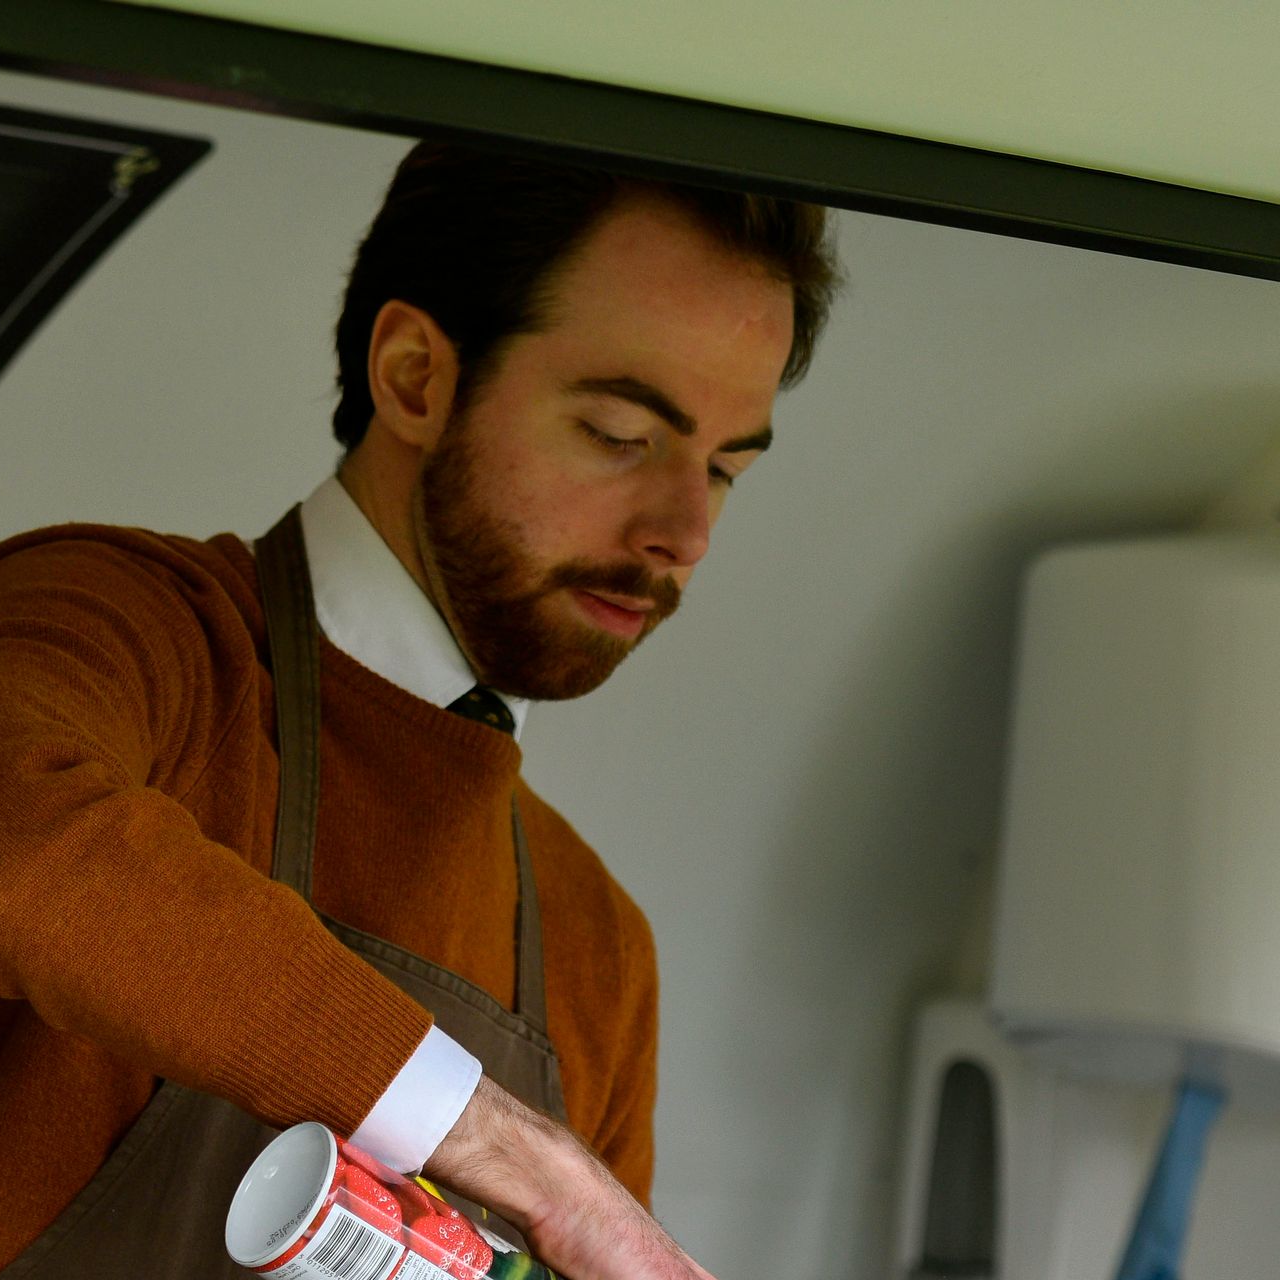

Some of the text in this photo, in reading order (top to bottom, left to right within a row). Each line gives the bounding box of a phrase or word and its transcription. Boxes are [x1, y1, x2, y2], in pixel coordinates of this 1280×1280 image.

[404, 1254, 413, 1266] This
[411, 1258, 419, 1268] Salt
[305, 1258, 334, 1279] 011295
[397, 1266, 406, 1276] can
[412, 1262, 426, 1280] Protein
